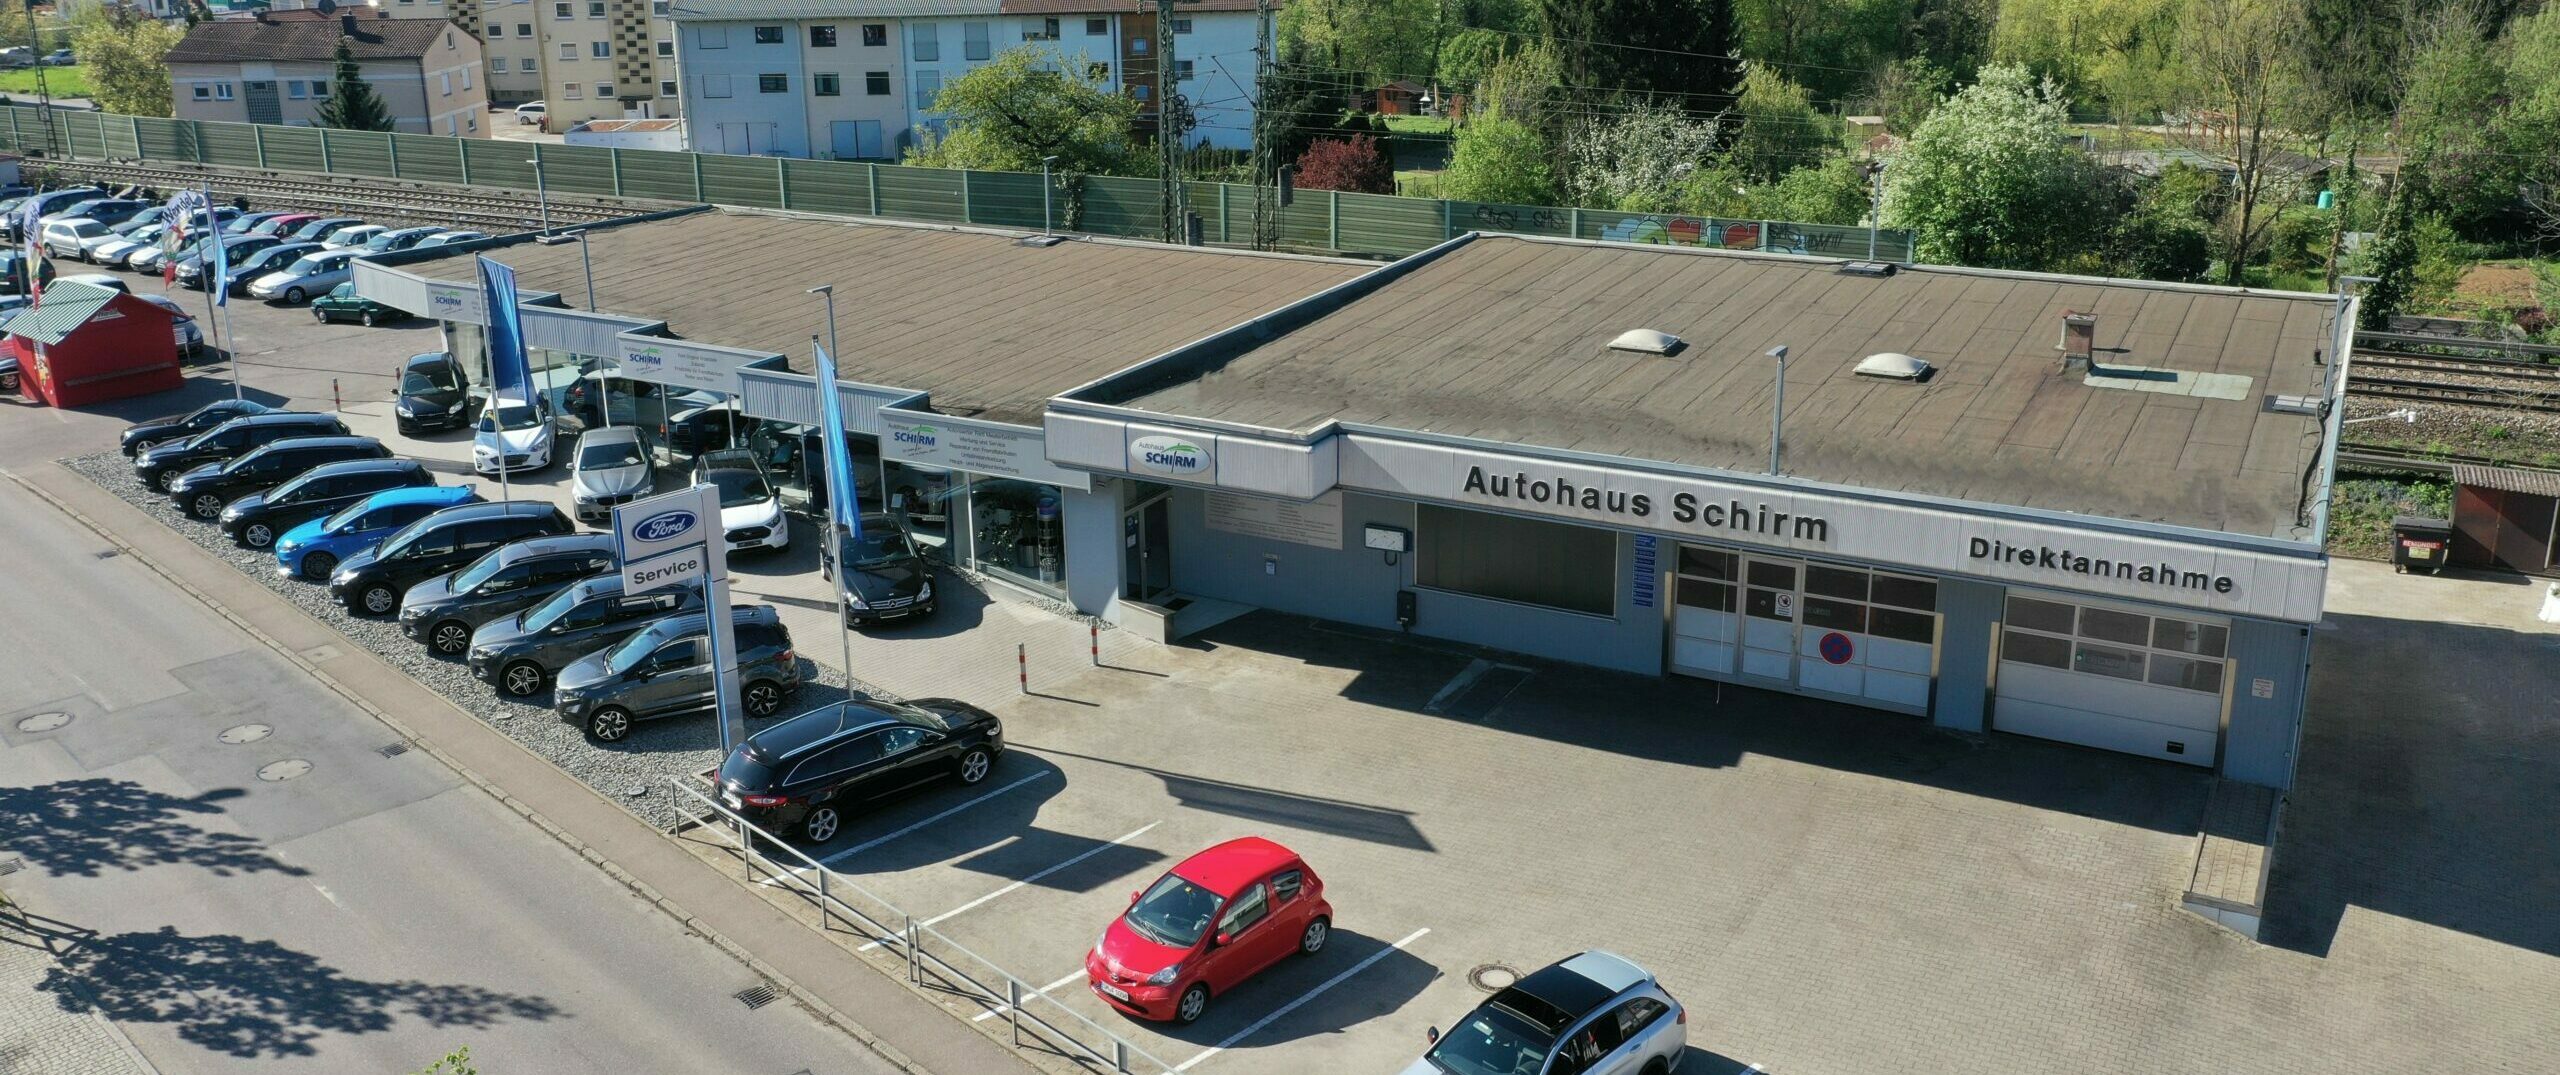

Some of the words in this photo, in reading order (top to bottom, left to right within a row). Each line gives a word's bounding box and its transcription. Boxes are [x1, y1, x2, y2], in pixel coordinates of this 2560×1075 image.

[435, 296, 462, 306] SCHIRM
[629, 353, 661, 366] SCHIRM
[894, 431, 936, 447] SCHIRM
[1145, 452, 1197, 469] SCHIRM
[1463, 465, 1652, 517] Autohaus
[1673, 491, 1827, 542] Schirm
[647, 516, 686, 539] Ford
[633, 559, 698, 585] Service
[1969, 536, 2233, 594] Direktannahme
